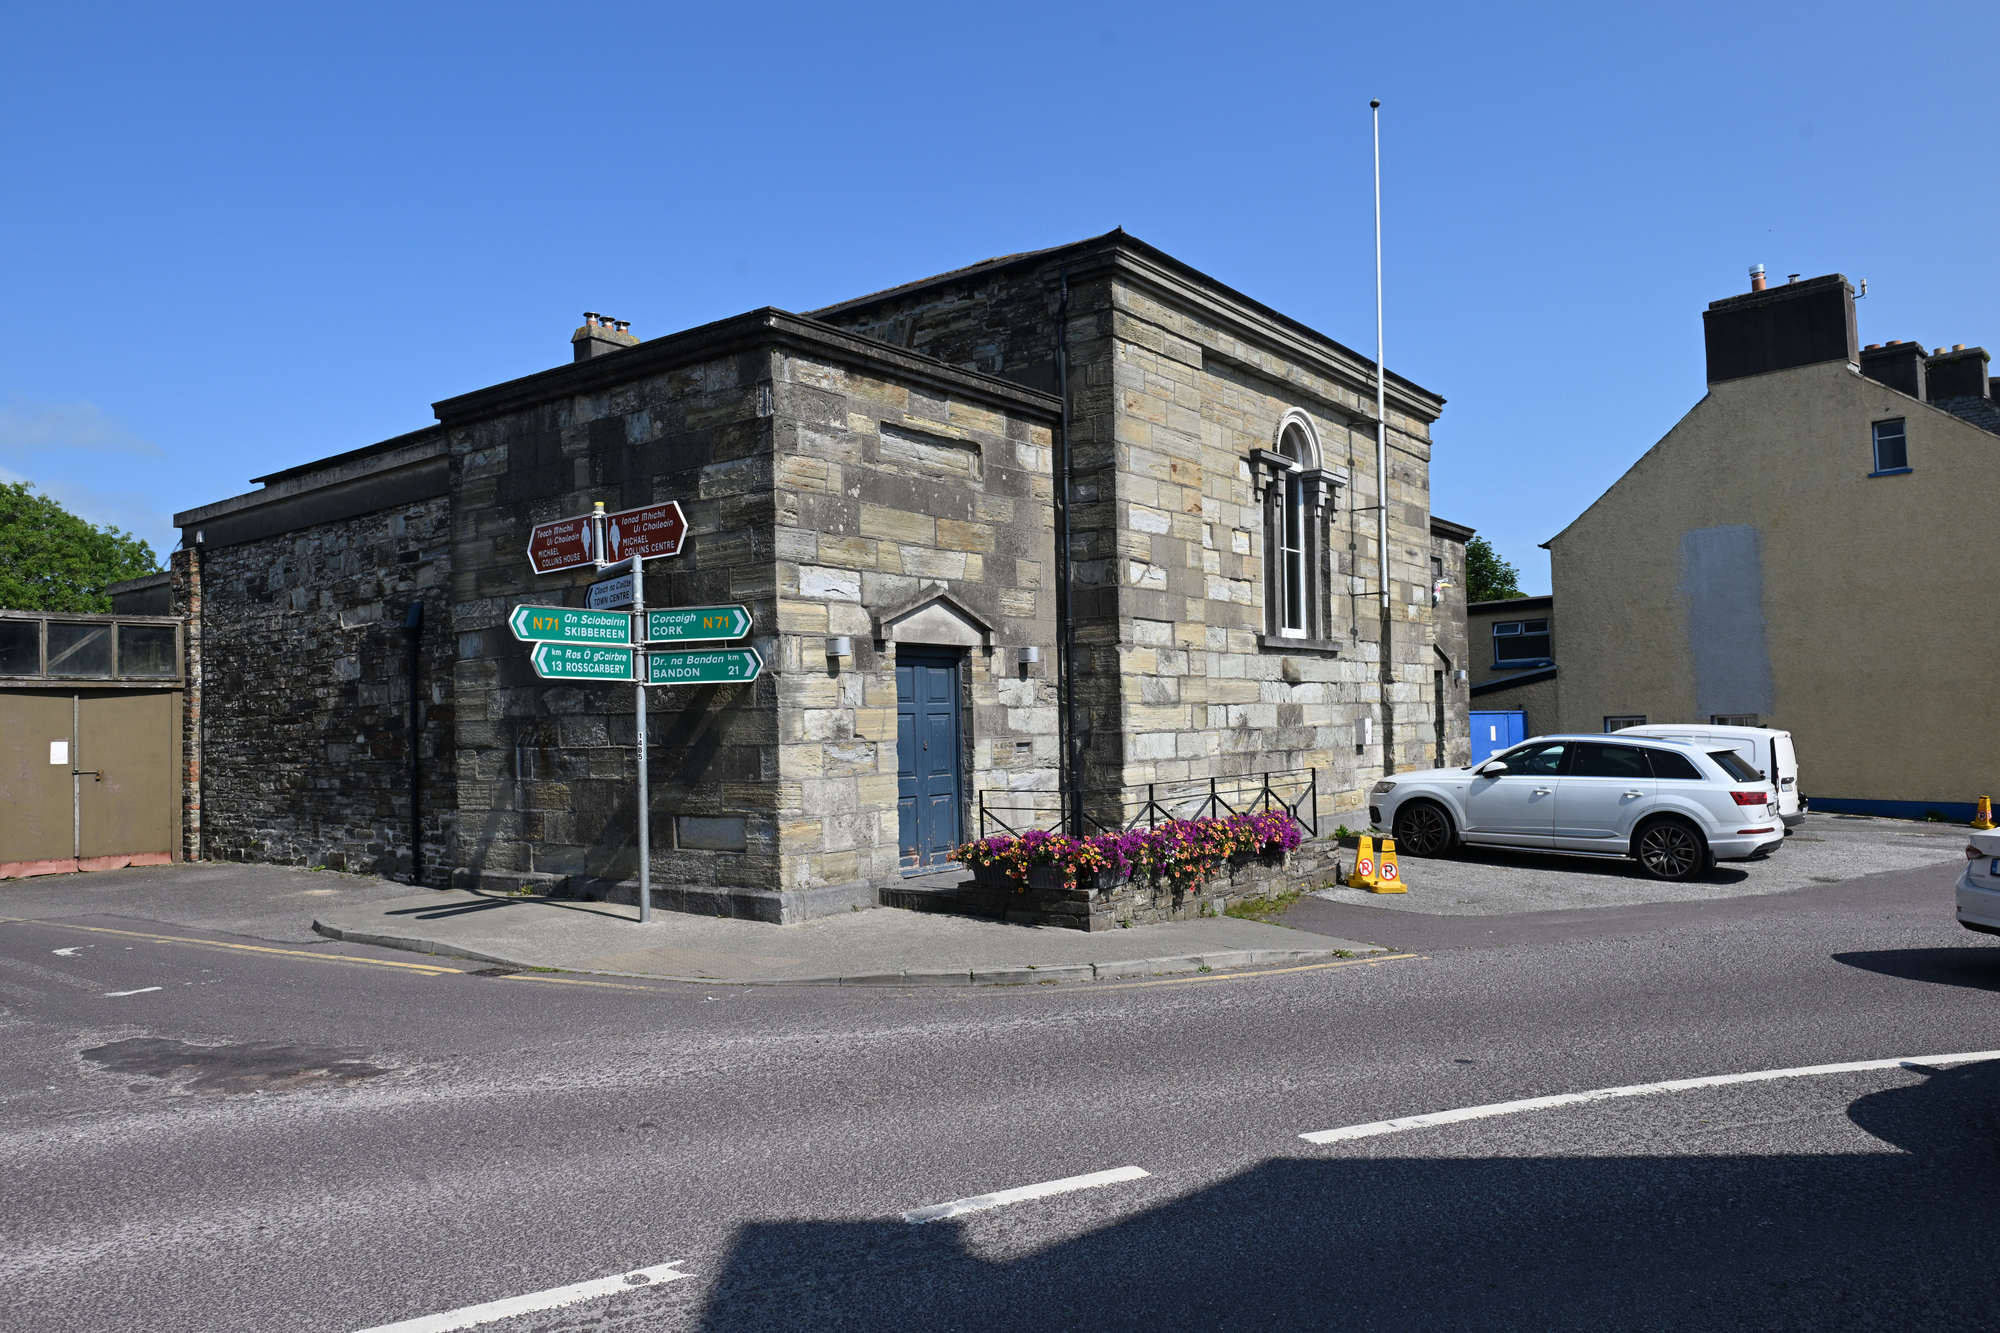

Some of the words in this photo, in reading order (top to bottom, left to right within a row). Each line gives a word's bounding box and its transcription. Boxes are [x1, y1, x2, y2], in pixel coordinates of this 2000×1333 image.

[622, 514, 639, 525] Ionad
[537, 529, 552, 538] Teach
[623, 535, 648, 546] MICHAEL
[538, 548, 559, 558] MICHAEL
[625, 545, 649, 556] COLLINS
[651, 540, 675, 552] CENTRE
[542, 556, 562, 567] COLLINS
[563, 553, 580, 563] HOUSE
[594, 596, 608, 606] TOWN
[610, 591, 629, 603] CENTRE
[652, 613, 697, 624] Corcaigh
[564, 627, 625, 638] SKIBBEREEN
[652, 626, 683, 636] CORK
[551, 648, 562, 656] km
[565, 649, 582, 659] Ros
[593, 651, 628, 662] gCairbre
[552, 661, 562, 671] 13
[652, 657, 667, 666] Dr.
[686, 655, 724, 665] Bandan
[566, 662, 625, 674] ROSSCARBERY
[653, 668, 700, 678] BANDON
[728, 665, 739, 675] 21
